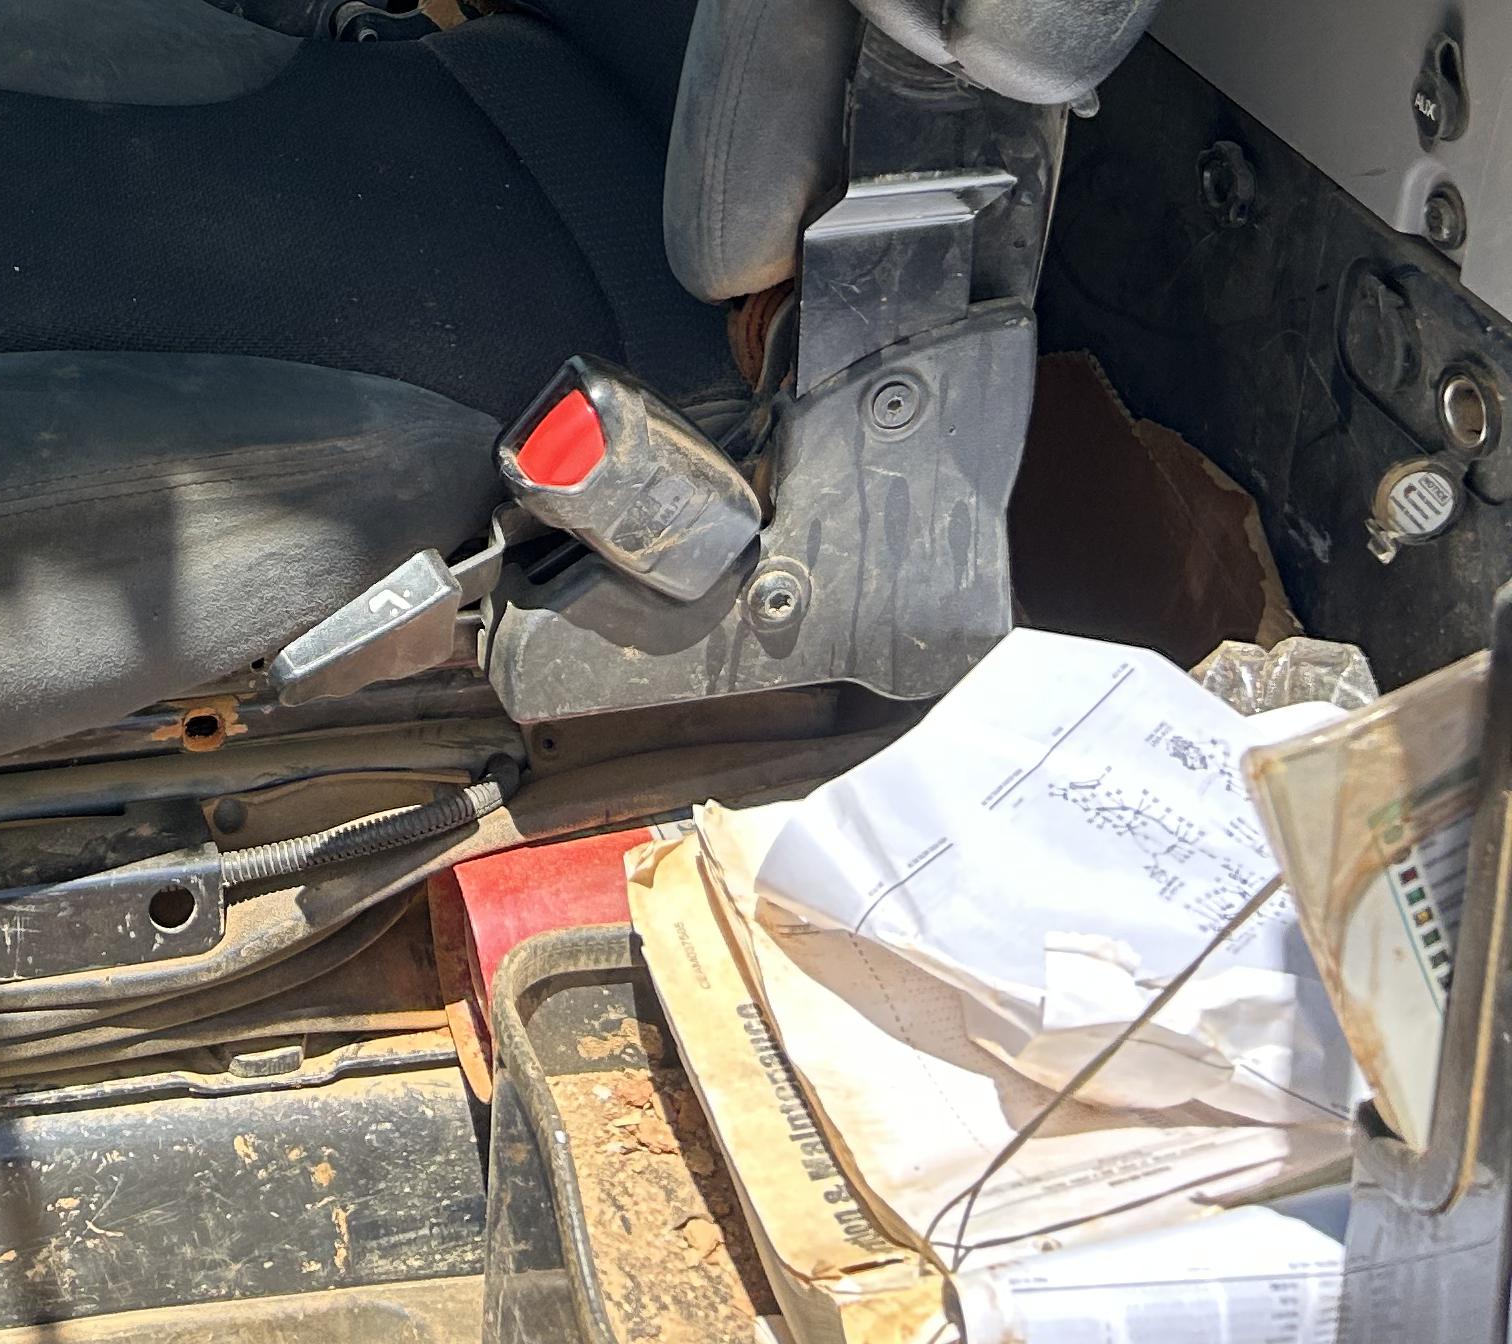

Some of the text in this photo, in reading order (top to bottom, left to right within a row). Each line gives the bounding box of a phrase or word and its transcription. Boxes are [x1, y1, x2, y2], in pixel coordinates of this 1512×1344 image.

[1414, 92, 1437, 121] AUX
[1422, 475, 1449, 502] NOTICE
[736, 1002, 840, 1182] Maintenance
[824, 1183, 856, 1205] &
